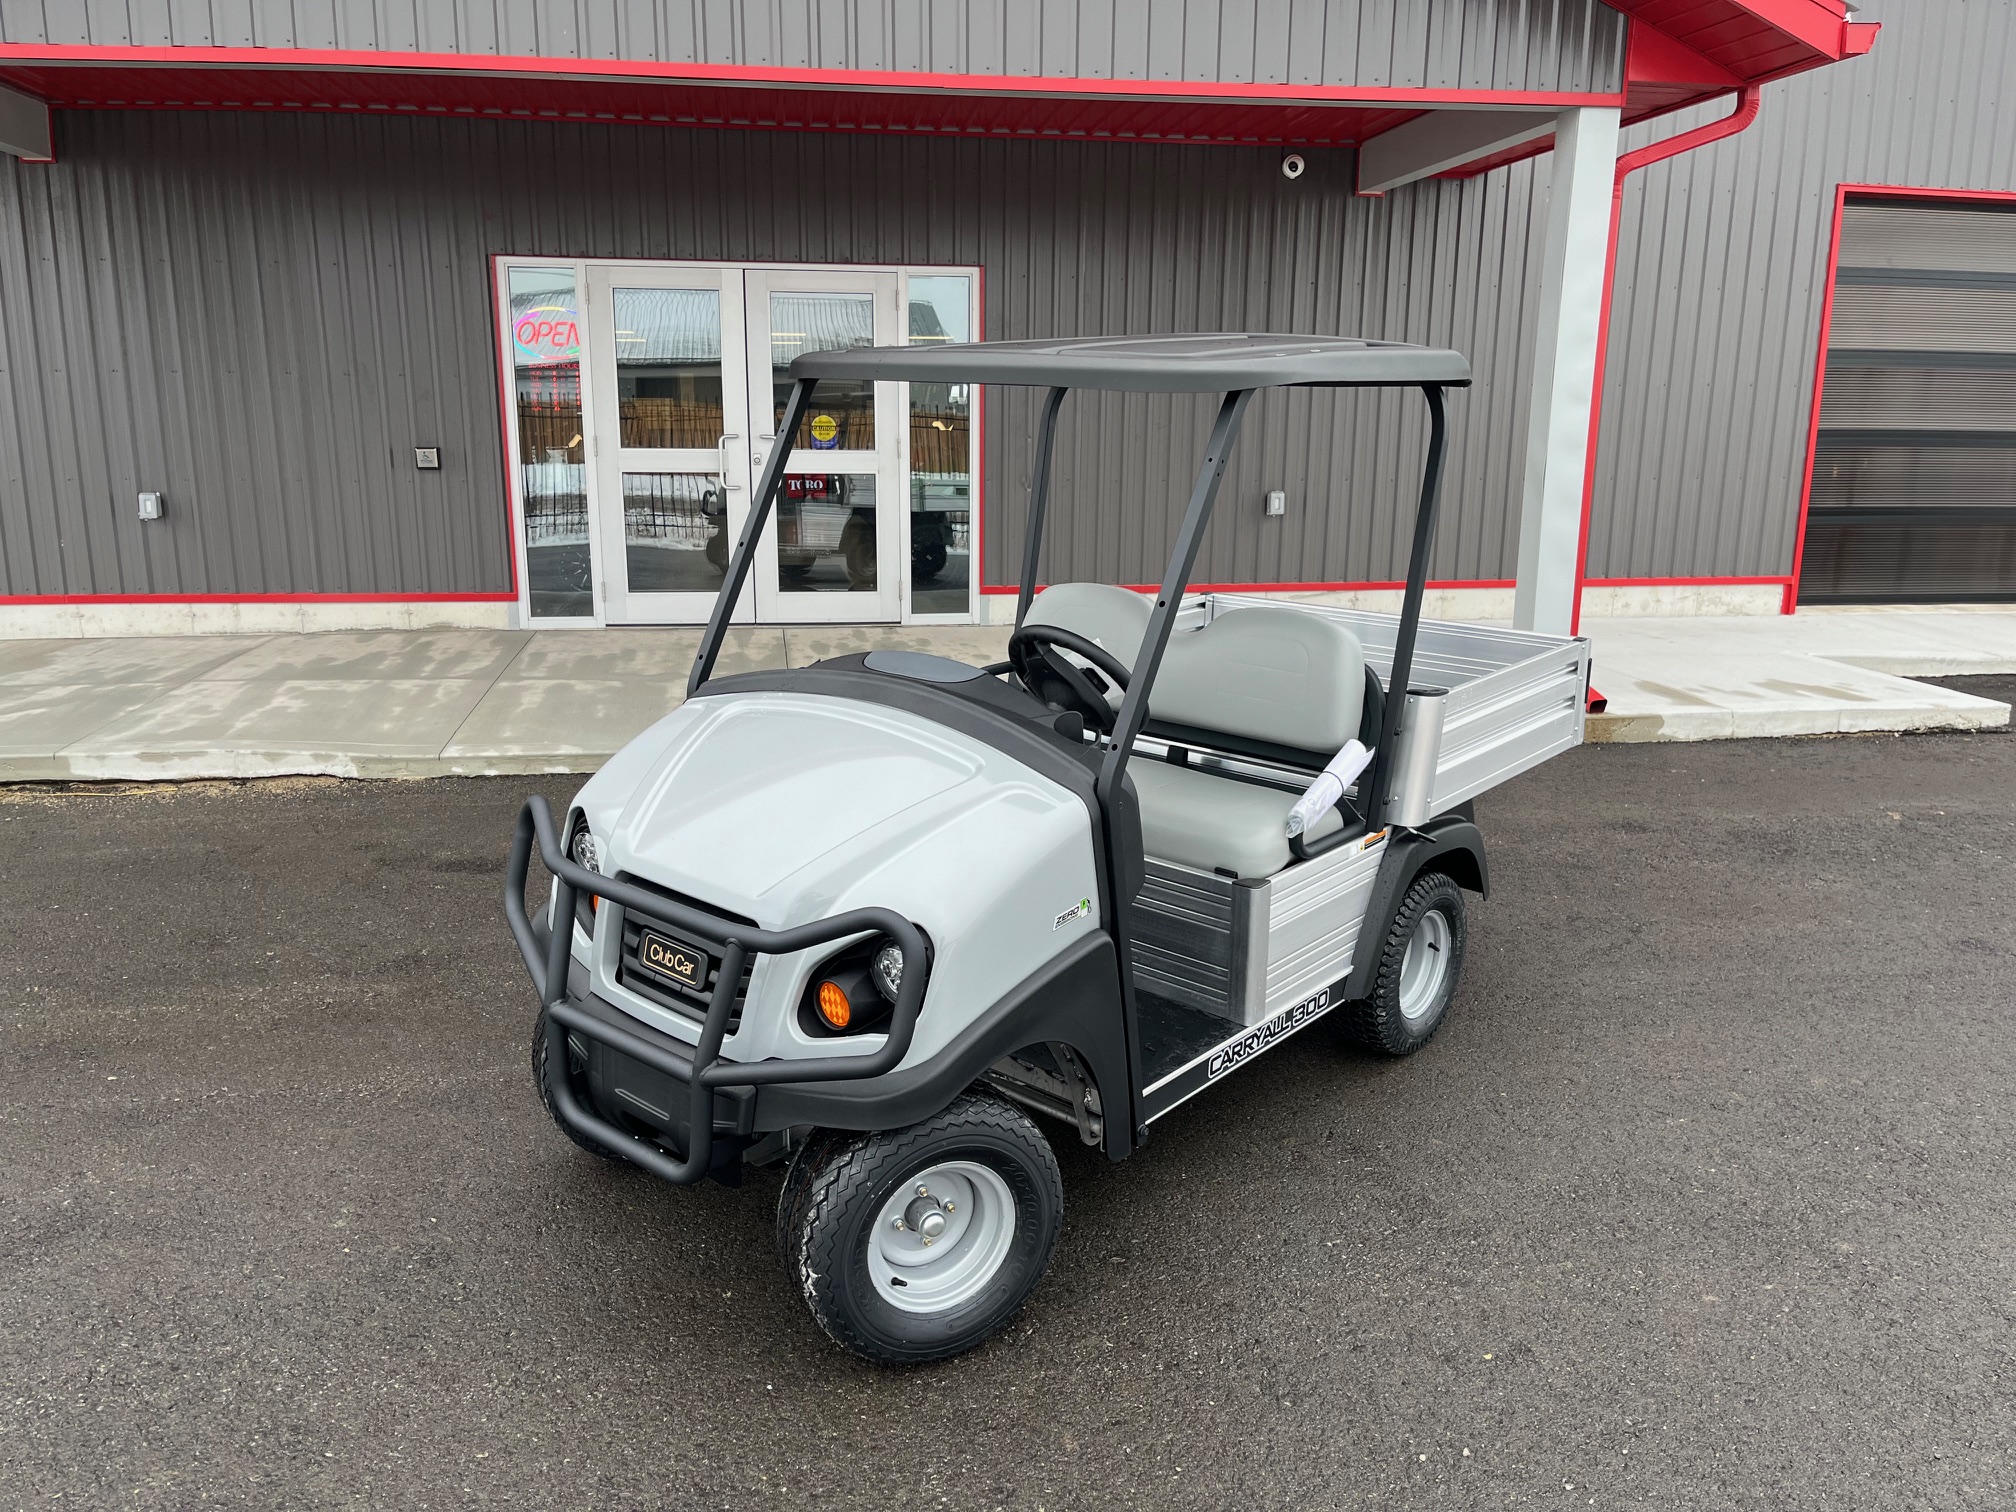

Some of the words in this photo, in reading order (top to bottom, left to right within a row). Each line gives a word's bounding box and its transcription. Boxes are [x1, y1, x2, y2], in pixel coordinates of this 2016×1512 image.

[517, 320, 580, 347] OPEN
[1056, 905, 1080, 925] ZERO
[650, 944, 674, 967] Club
[674, 954, 695, 975] Car
[1208, 1014, 1291, 1078] CARRYALL
[1292, 988, 1330, 1027] 300
